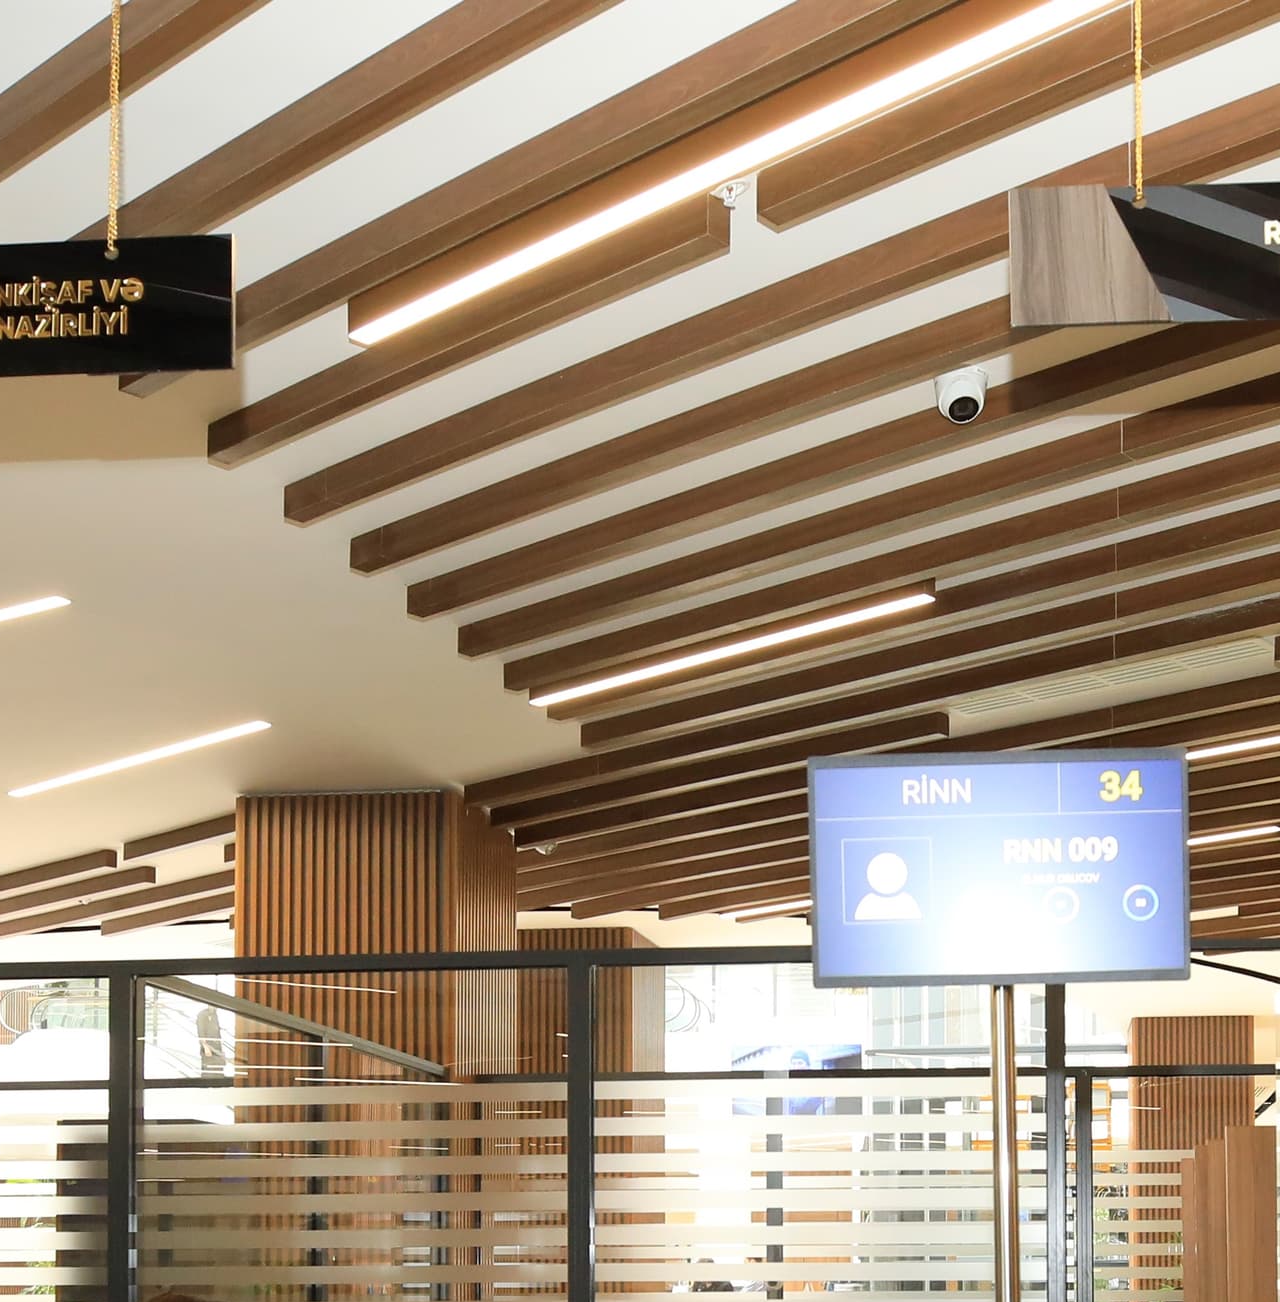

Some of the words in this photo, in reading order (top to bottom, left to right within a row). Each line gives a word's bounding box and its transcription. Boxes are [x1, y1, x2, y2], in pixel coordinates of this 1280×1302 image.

[100, 276, 145, 302] VƏ
[902, 774, 972, 805] RİNN
[1098, 769, 1144, 802] 34
[1003, 838, 1062, 864] RNN
[1068, 836, 1119, 862] 009
